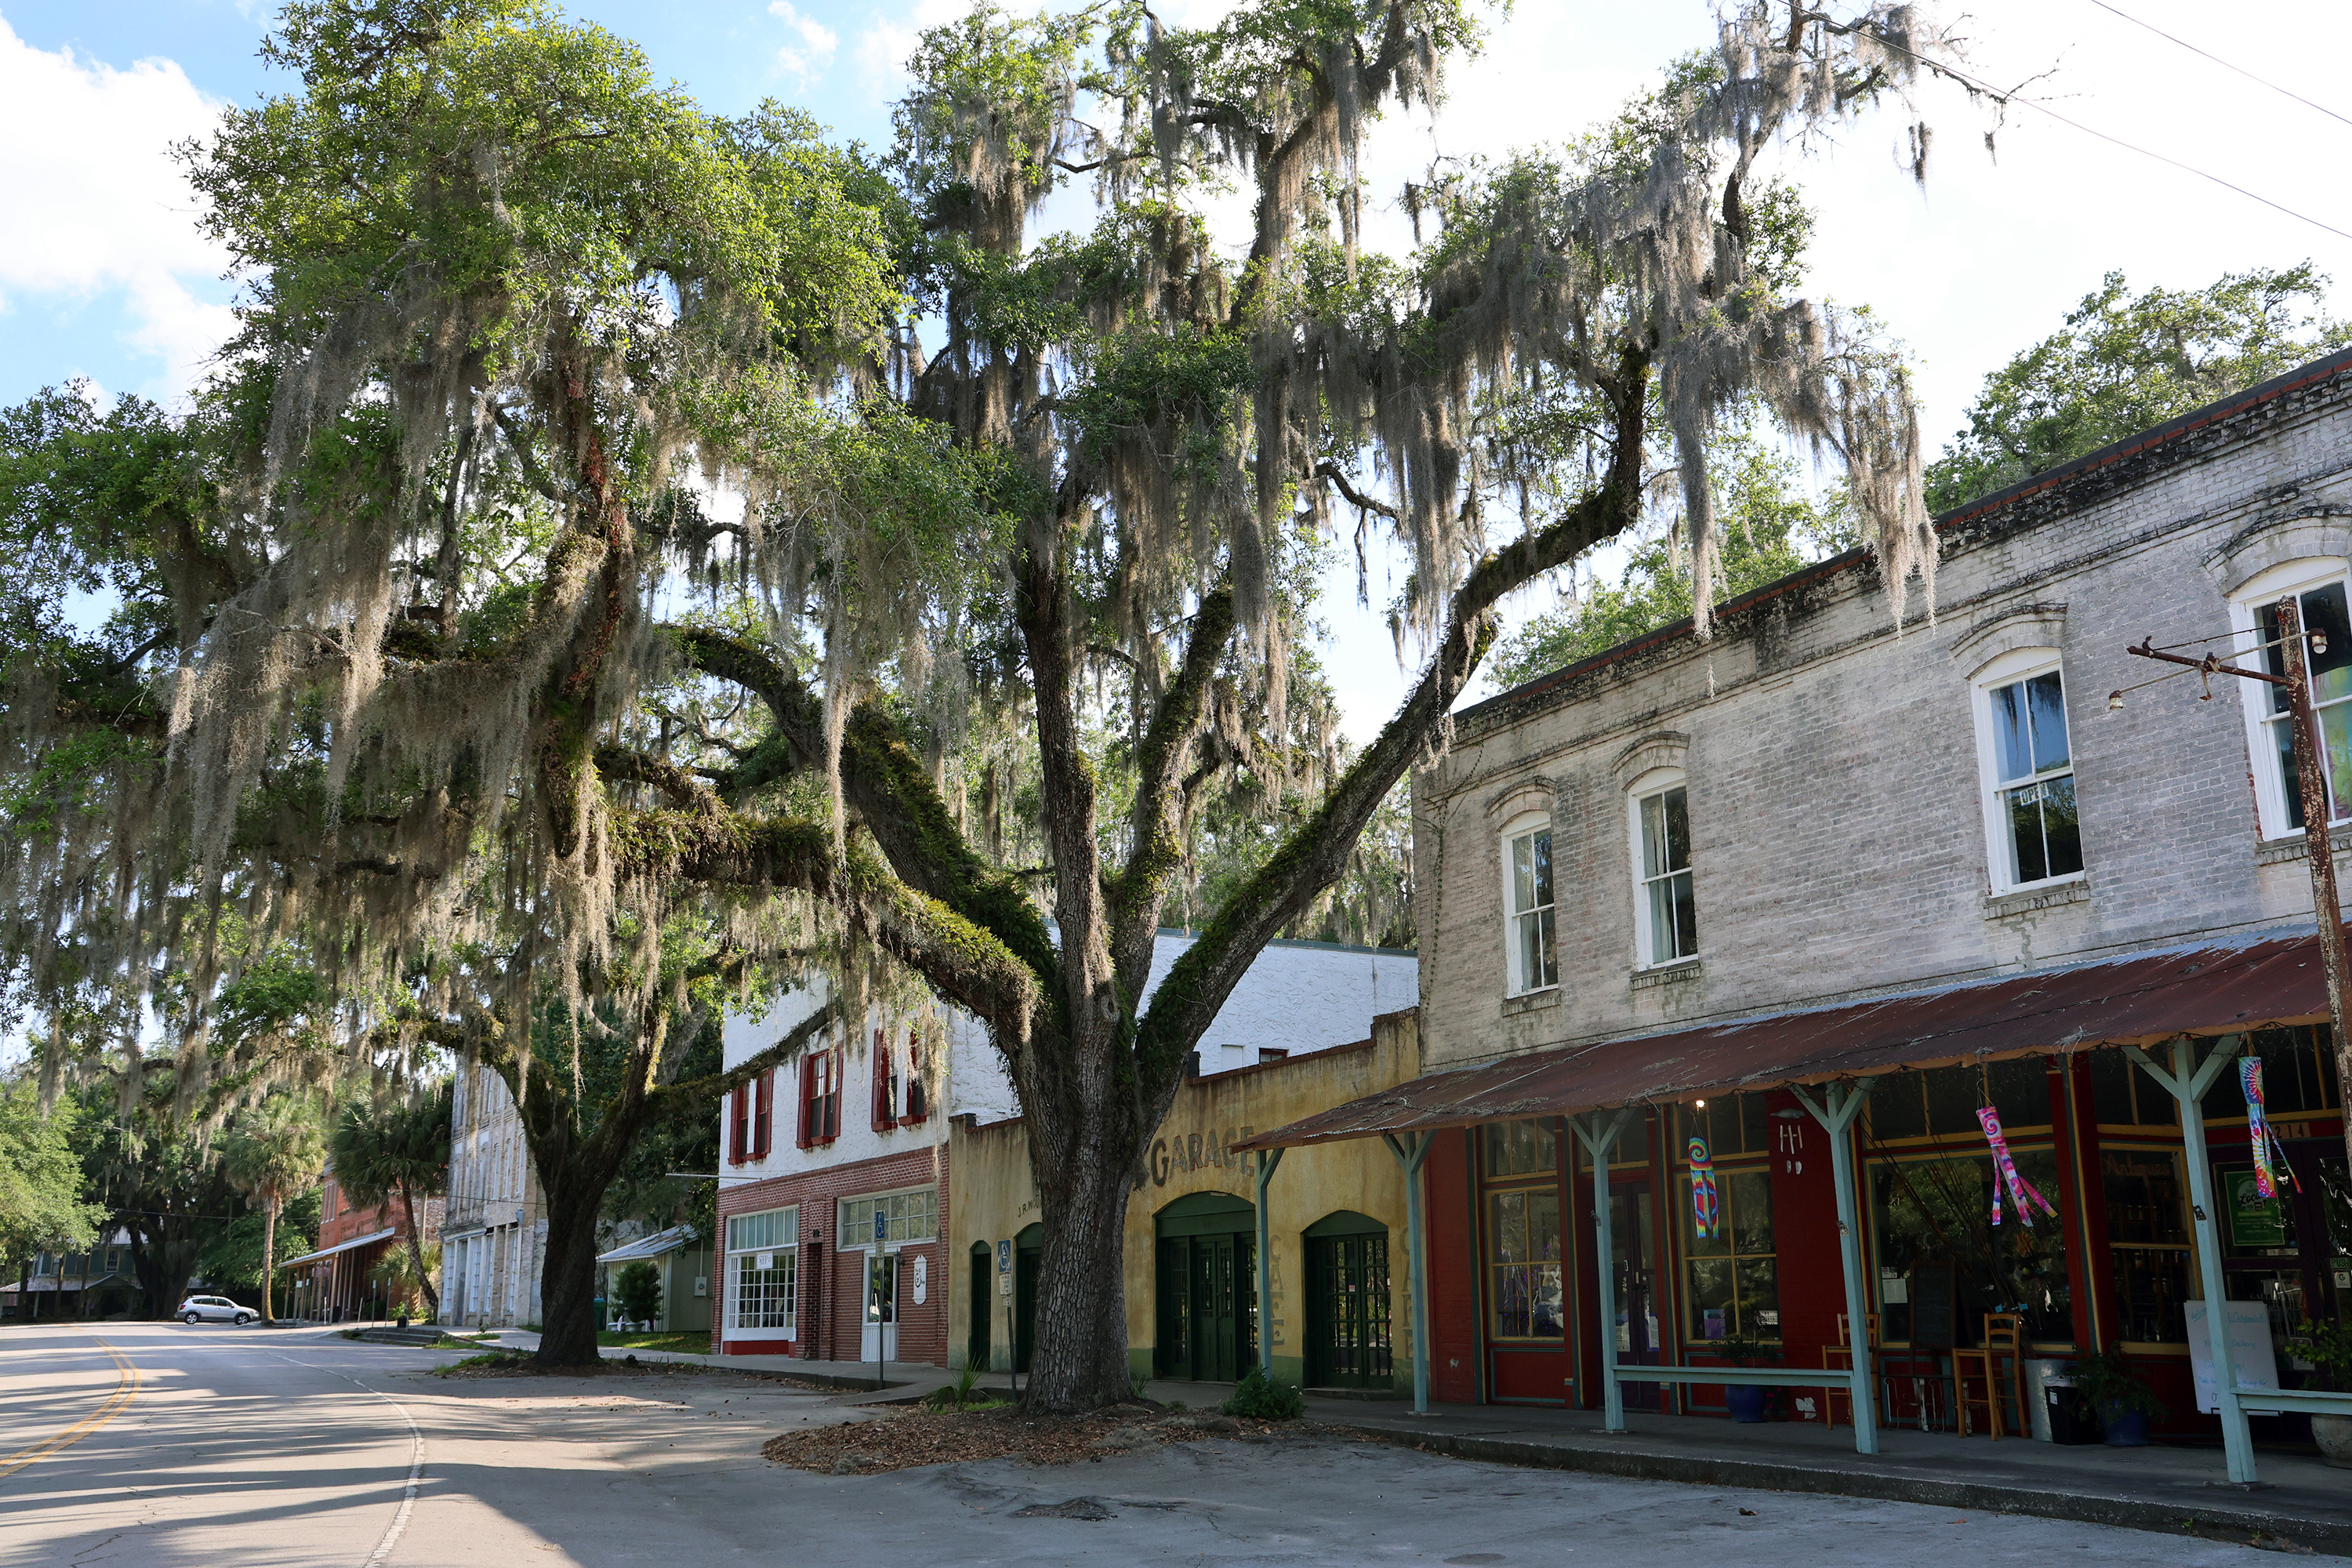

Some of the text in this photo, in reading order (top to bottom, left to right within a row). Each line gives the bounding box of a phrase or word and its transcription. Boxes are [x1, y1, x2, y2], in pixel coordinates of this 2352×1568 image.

[2021, 783, 2047, 804] OPEN
[2274, 1123, 2304, 1139] 214
[1150, 1126, 1254, 1189] GARAGE
[2238, 1192, 2262, 1205] Loca
[2332, 1258, 2350, 1267] PUSH
